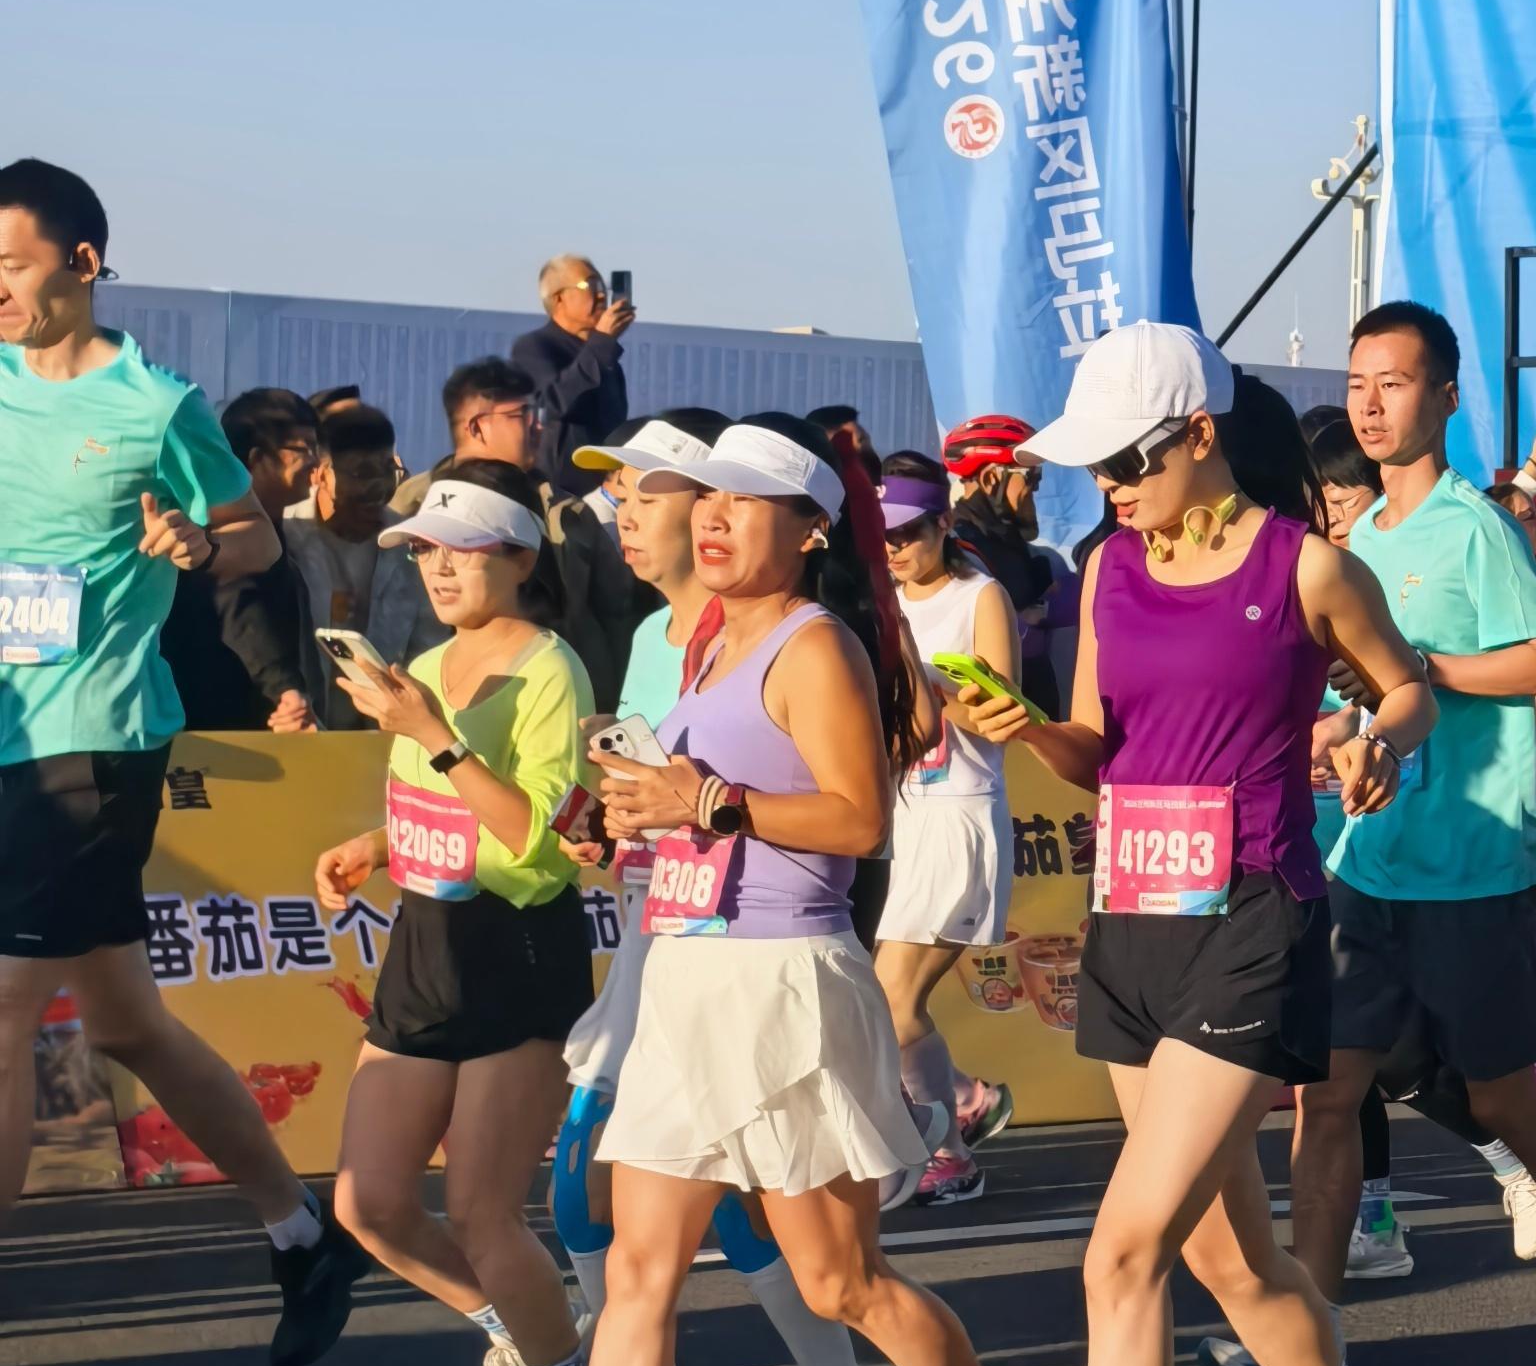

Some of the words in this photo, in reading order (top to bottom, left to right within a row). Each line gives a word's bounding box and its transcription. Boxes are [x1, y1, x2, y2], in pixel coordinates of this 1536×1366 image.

[391, 815, 467, 871] 42069
[1118, 829, 1215, 877] 41293
[649, 855, 717, 908] 0308
[145, 897, 402, 978] 番茄是个
